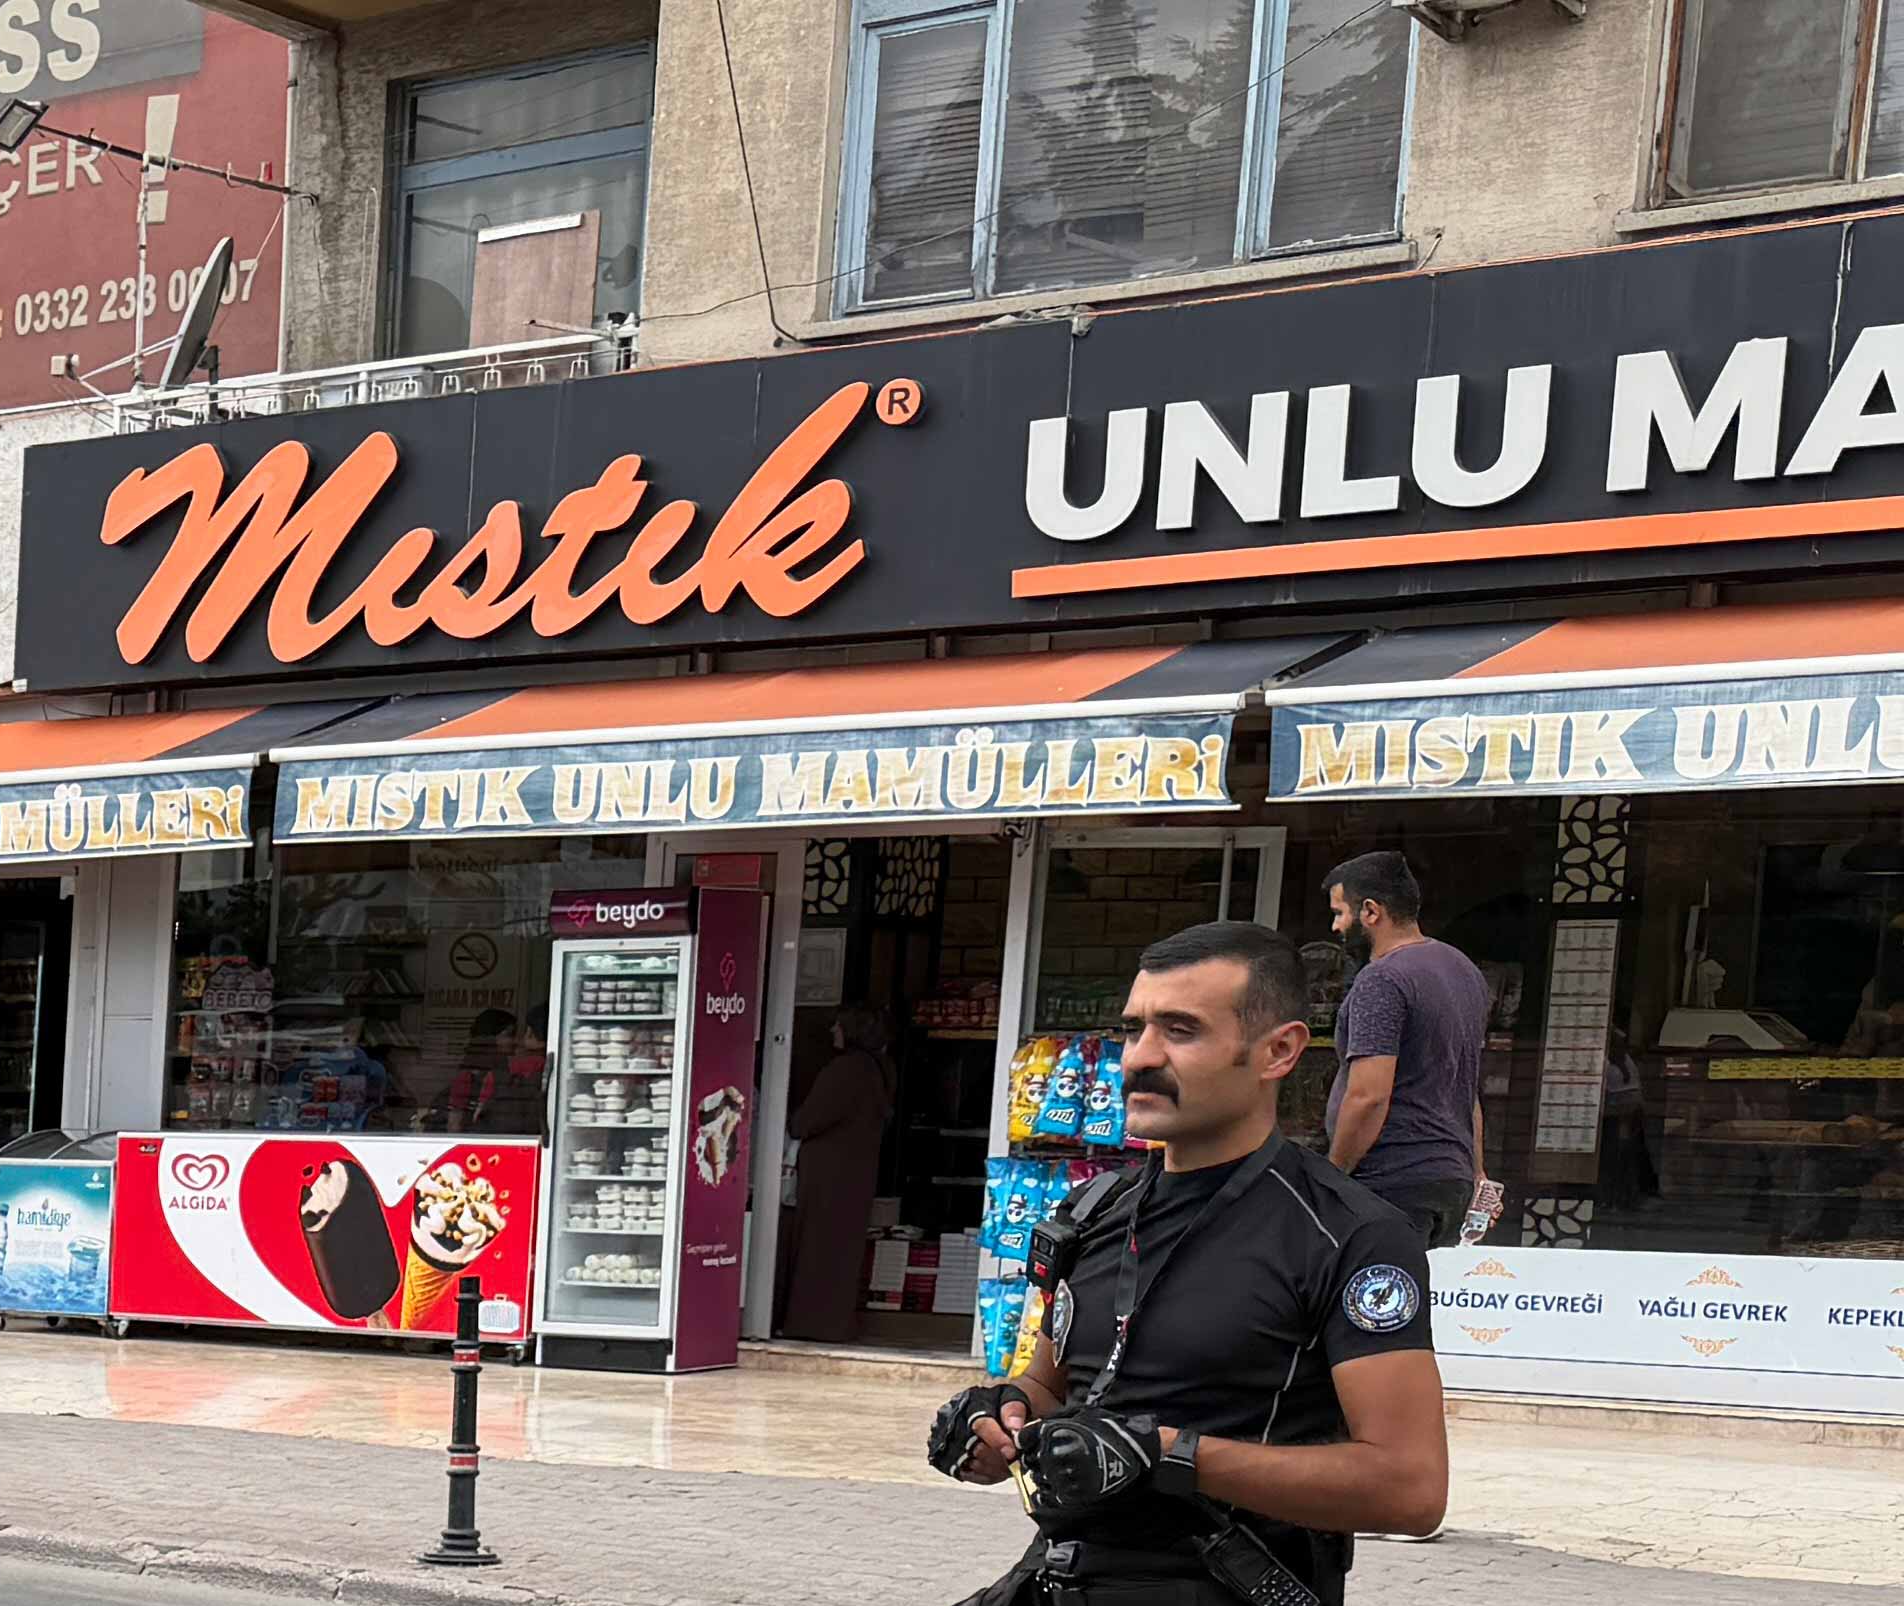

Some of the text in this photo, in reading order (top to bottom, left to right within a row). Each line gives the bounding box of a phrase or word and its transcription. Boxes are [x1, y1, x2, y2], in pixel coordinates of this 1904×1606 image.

[14, 284, 89, 336] 0332
[1024, 363, 1552, 542] UNLU
[1294, 707, 1659, 793] MISTIK
[289, 766, 534, 836] MISTIK
[552, 756, 743, 829] UNLU
[595, 900, 664, 929] beydo
[705, 991, 746, 1023] beydo
[1430, 1288, 1603, 1315] BUĞDAY GEVREĞİ
[1637, 1295, 1788, 1323] YAĞLI GEVREK
